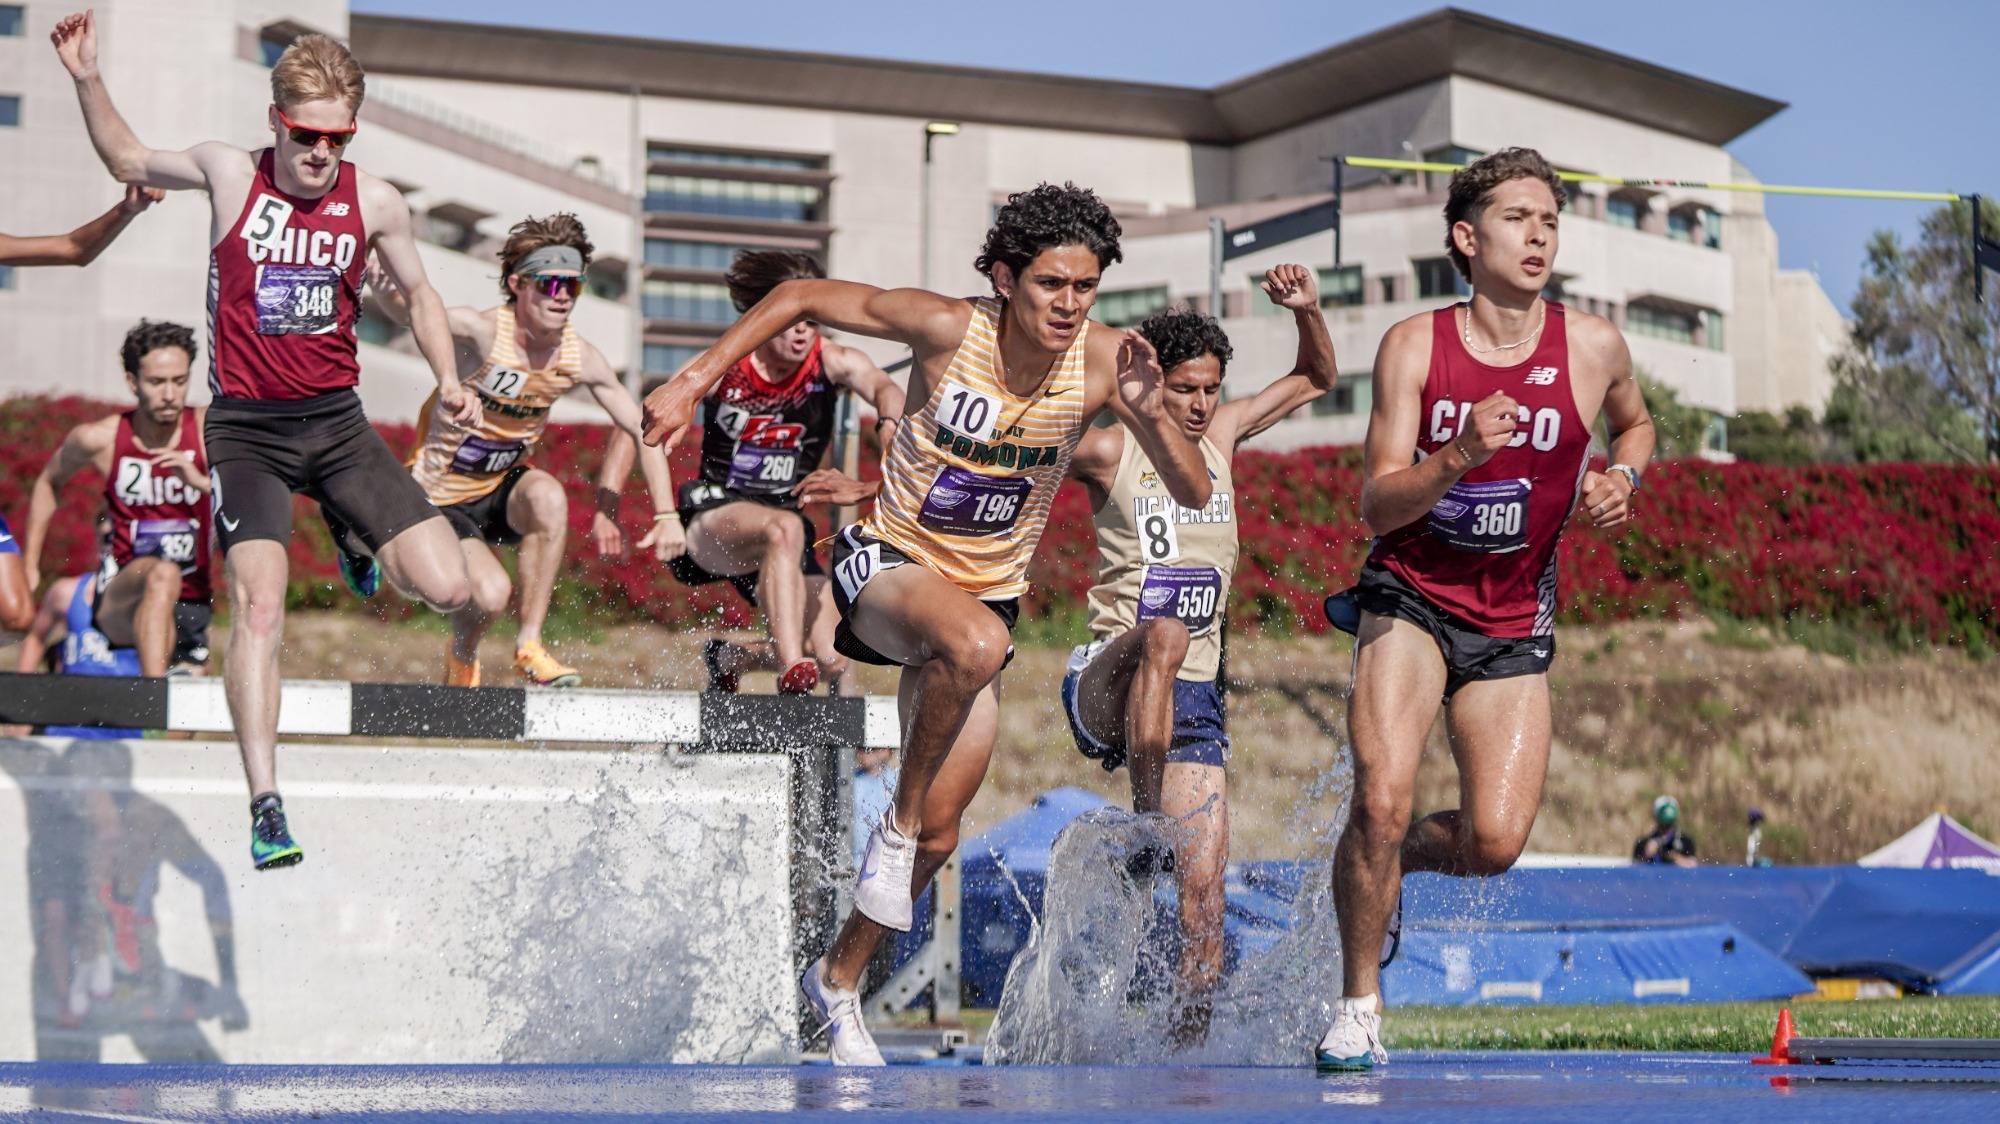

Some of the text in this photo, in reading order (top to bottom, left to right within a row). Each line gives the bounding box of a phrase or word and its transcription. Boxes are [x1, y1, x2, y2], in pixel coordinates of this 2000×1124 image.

[250, 199, 284, 241] 5
[294, 285, 334, 317] 348
[493, 371, 519, 396] 12
[722, 411, 740, 434] 4
[951, 391, 989, 434] 10
[1430, 400, 1561, 452] CCO
[934, 424, 1059, 471] POMONA
[125, 463, 142, 496] 2
[760, 455, 795, 481] 260
[972, 493, 1020, 523] 196
[1472, 502, 1522, 536] 360
[160, 533, 194, 558] 352
[1144, 515, 1171, 559] 8
[842, 549, 871, 593] 10
[1176, 585, 1216, 618] 550
